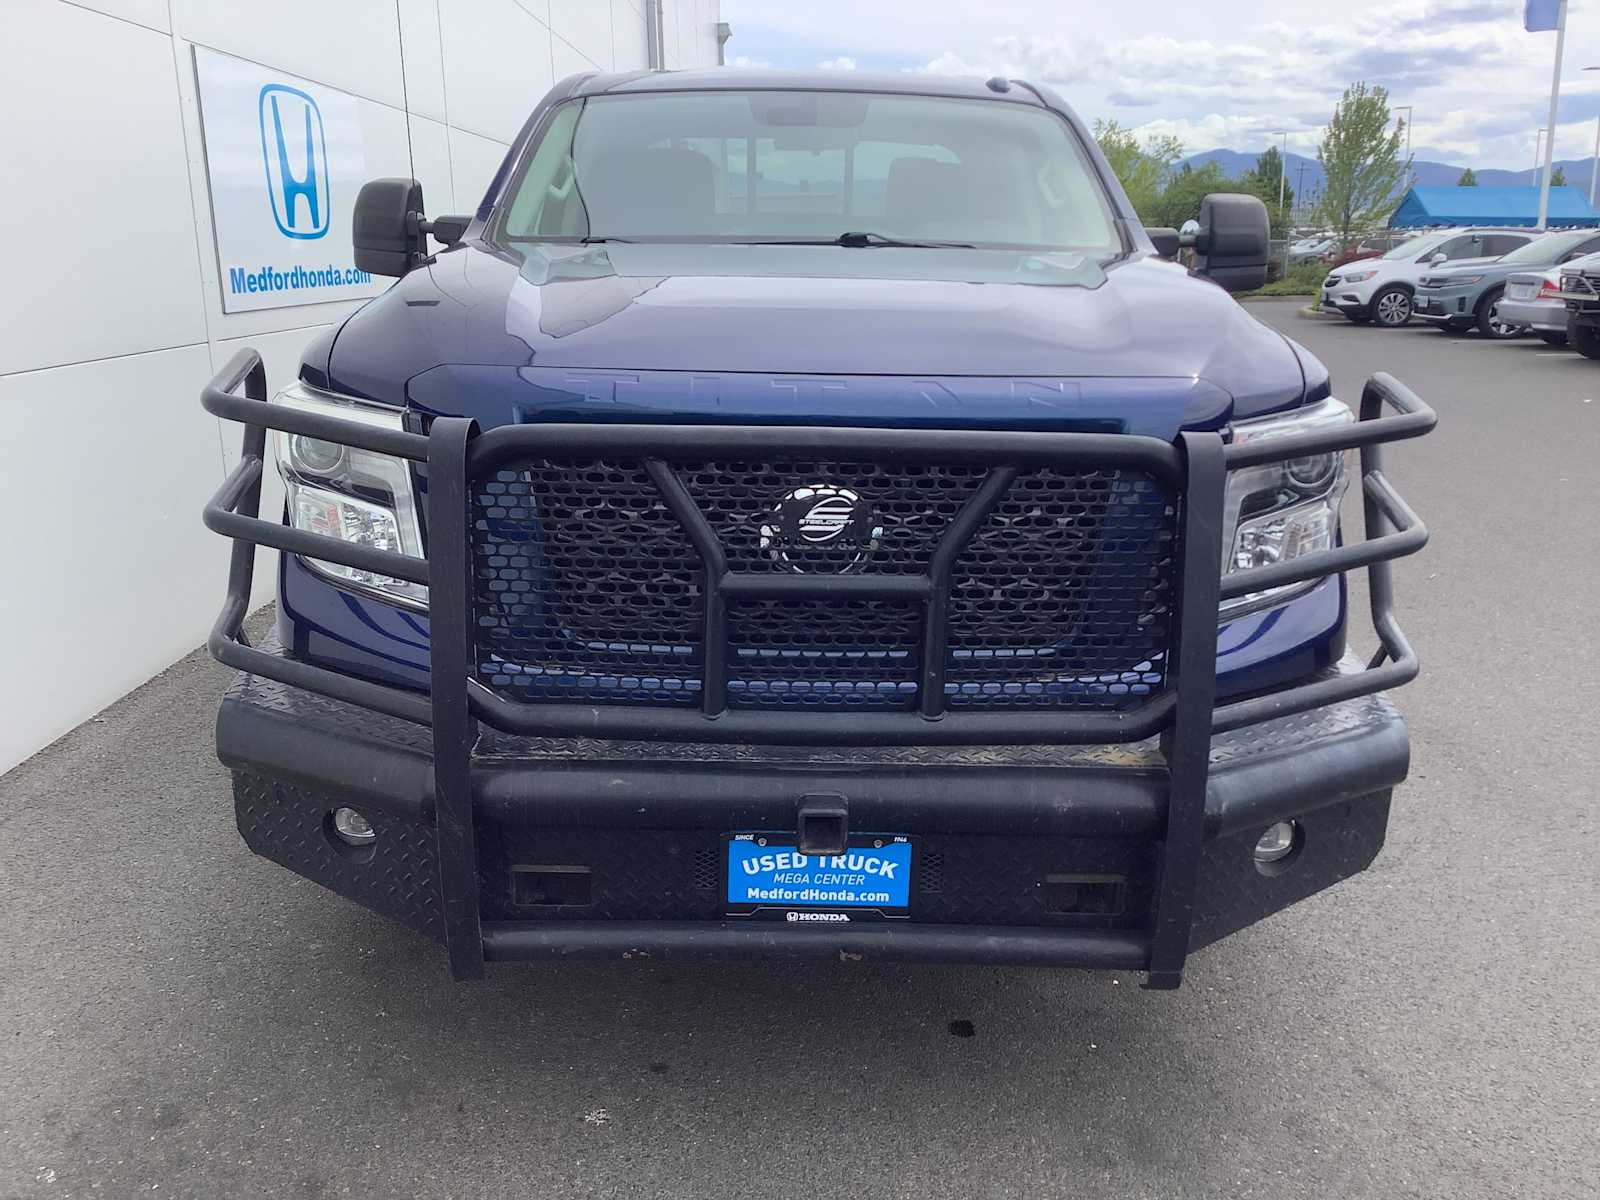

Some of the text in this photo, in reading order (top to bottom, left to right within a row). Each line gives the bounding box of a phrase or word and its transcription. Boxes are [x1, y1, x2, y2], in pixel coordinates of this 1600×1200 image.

[229, 264, 371, 294] Medfordhonda.com
[742, 852, 898, 879] USED TRUCK
[773, 873, 865, 885] MEGA CENTER
[747, 887, 890, 902] MedfordHonda.com
[798, 913, 850, 921] HONDA
